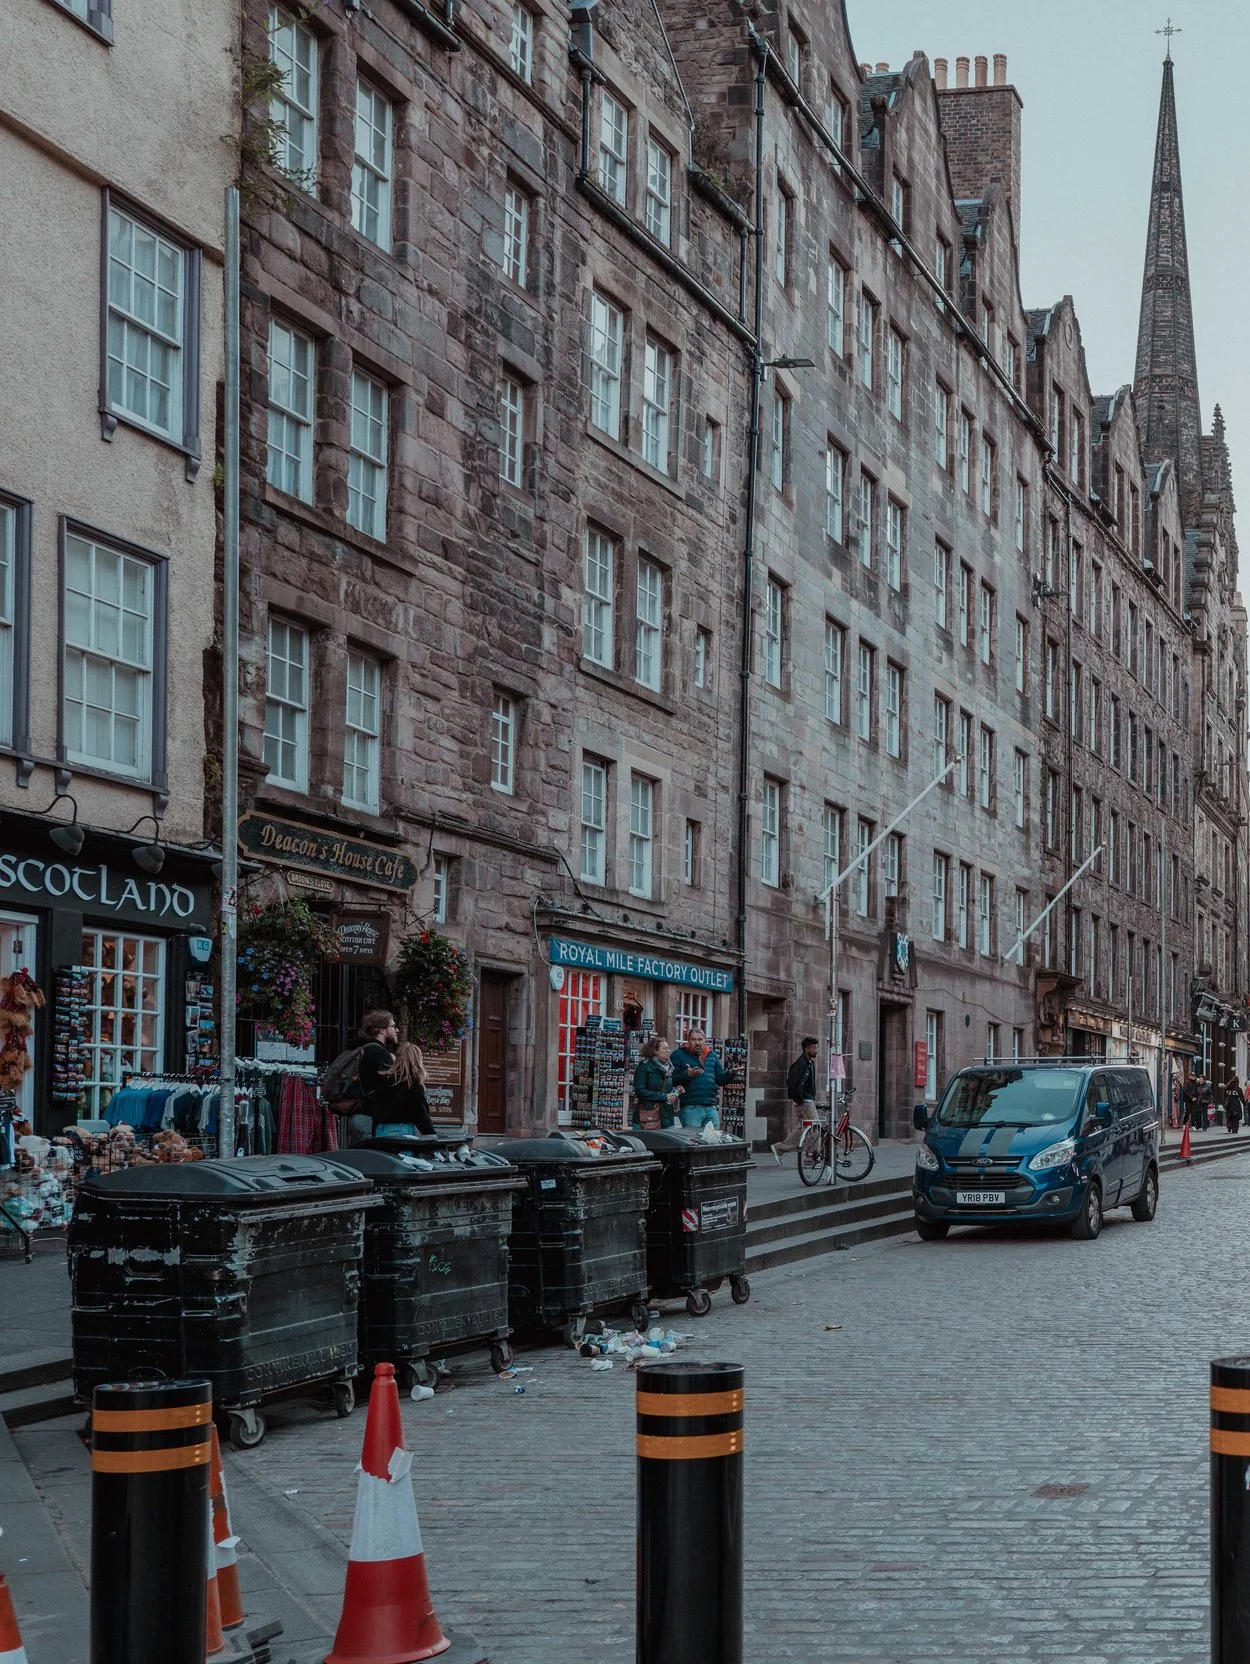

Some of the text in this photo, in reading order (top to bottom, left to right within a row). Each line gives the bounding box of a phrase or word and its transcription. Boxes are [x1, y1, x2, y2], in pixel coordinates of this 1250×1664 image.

[330, 841, 373, 870] House
[0, 854, 195, 917] SCOTLAND
[353, 945, 360, 955] 7
[559, 943, 602, 966] ROYAL
[606, 952, 635, 972] MILE
[637, 957, 688, 979] FACTORY
[690, 967, 728, 989] OUTLET
[1232, 1020, 1240, 1029] K
[962, 1194, 1000, 1202] YR18 PBV
[247, 1348, 326, 1381] CONTINENTAL
